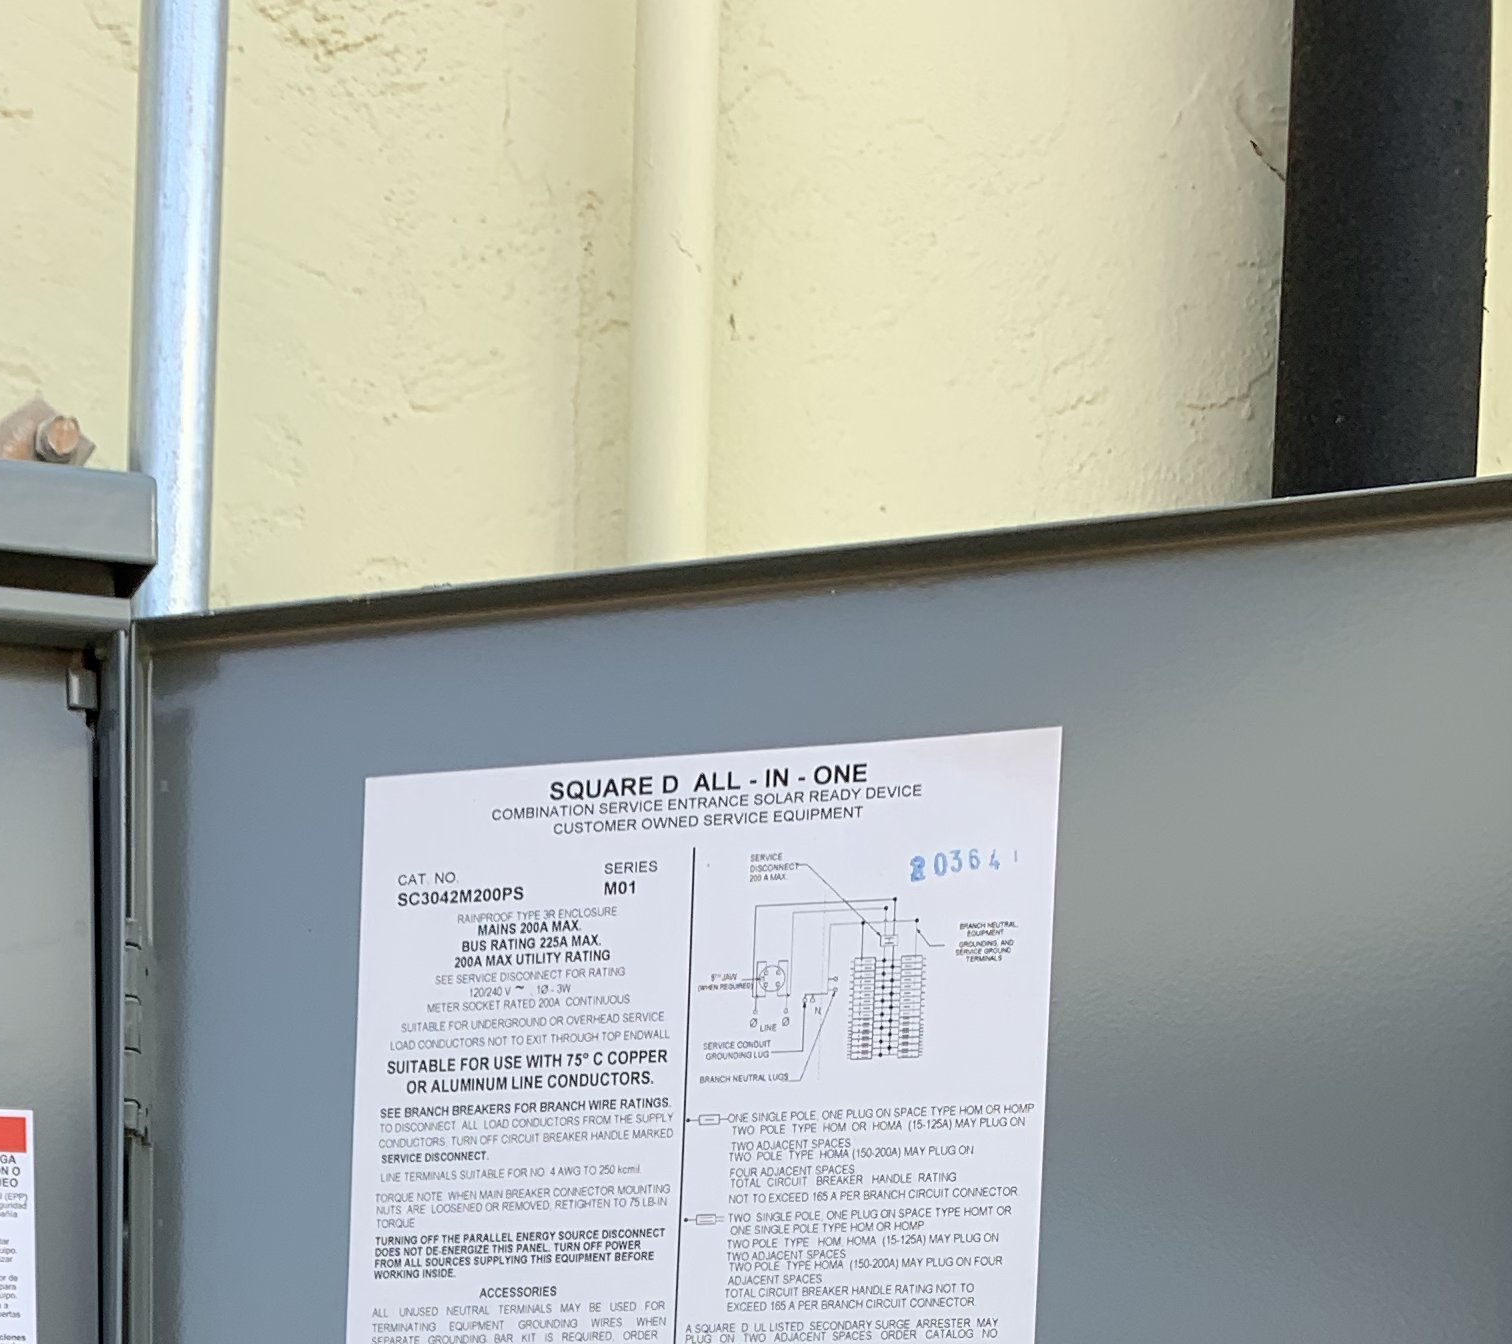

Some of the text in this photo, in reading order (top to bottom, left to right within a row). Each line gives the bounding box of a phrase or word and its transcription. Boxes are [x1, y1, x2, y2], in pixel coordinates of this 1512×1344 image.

[549, 763, 868, 801] SQUARE D ALL IN ONE
[491, 784, 922, 821] COMBINATION SERVICE ENTRANCE SOLAR READY DEVICE
[553, 806, 864, 835] CUSTOMER OWNED SERVICE EQUIPMENT
[604, 860, 658, 875] SERIES
[397, 886, 524, 907] SC3042M200PS
[604, 880, 636, 896] M01
[477, 923, 517, 936] MAINS
[519, 922, 549, 934] 200A
[386, 1058, 456, 1075] SUITABLE
[460, 1056, 490, 1072] FOR
[493, 1055, 522, 1071] USE
[525, 1053, 562, 1069] WITH
[593, 1051, 603, 1066] C
[607, 1049, 668, 1066] COPPER
[11, 1166, 21, 1177] O
